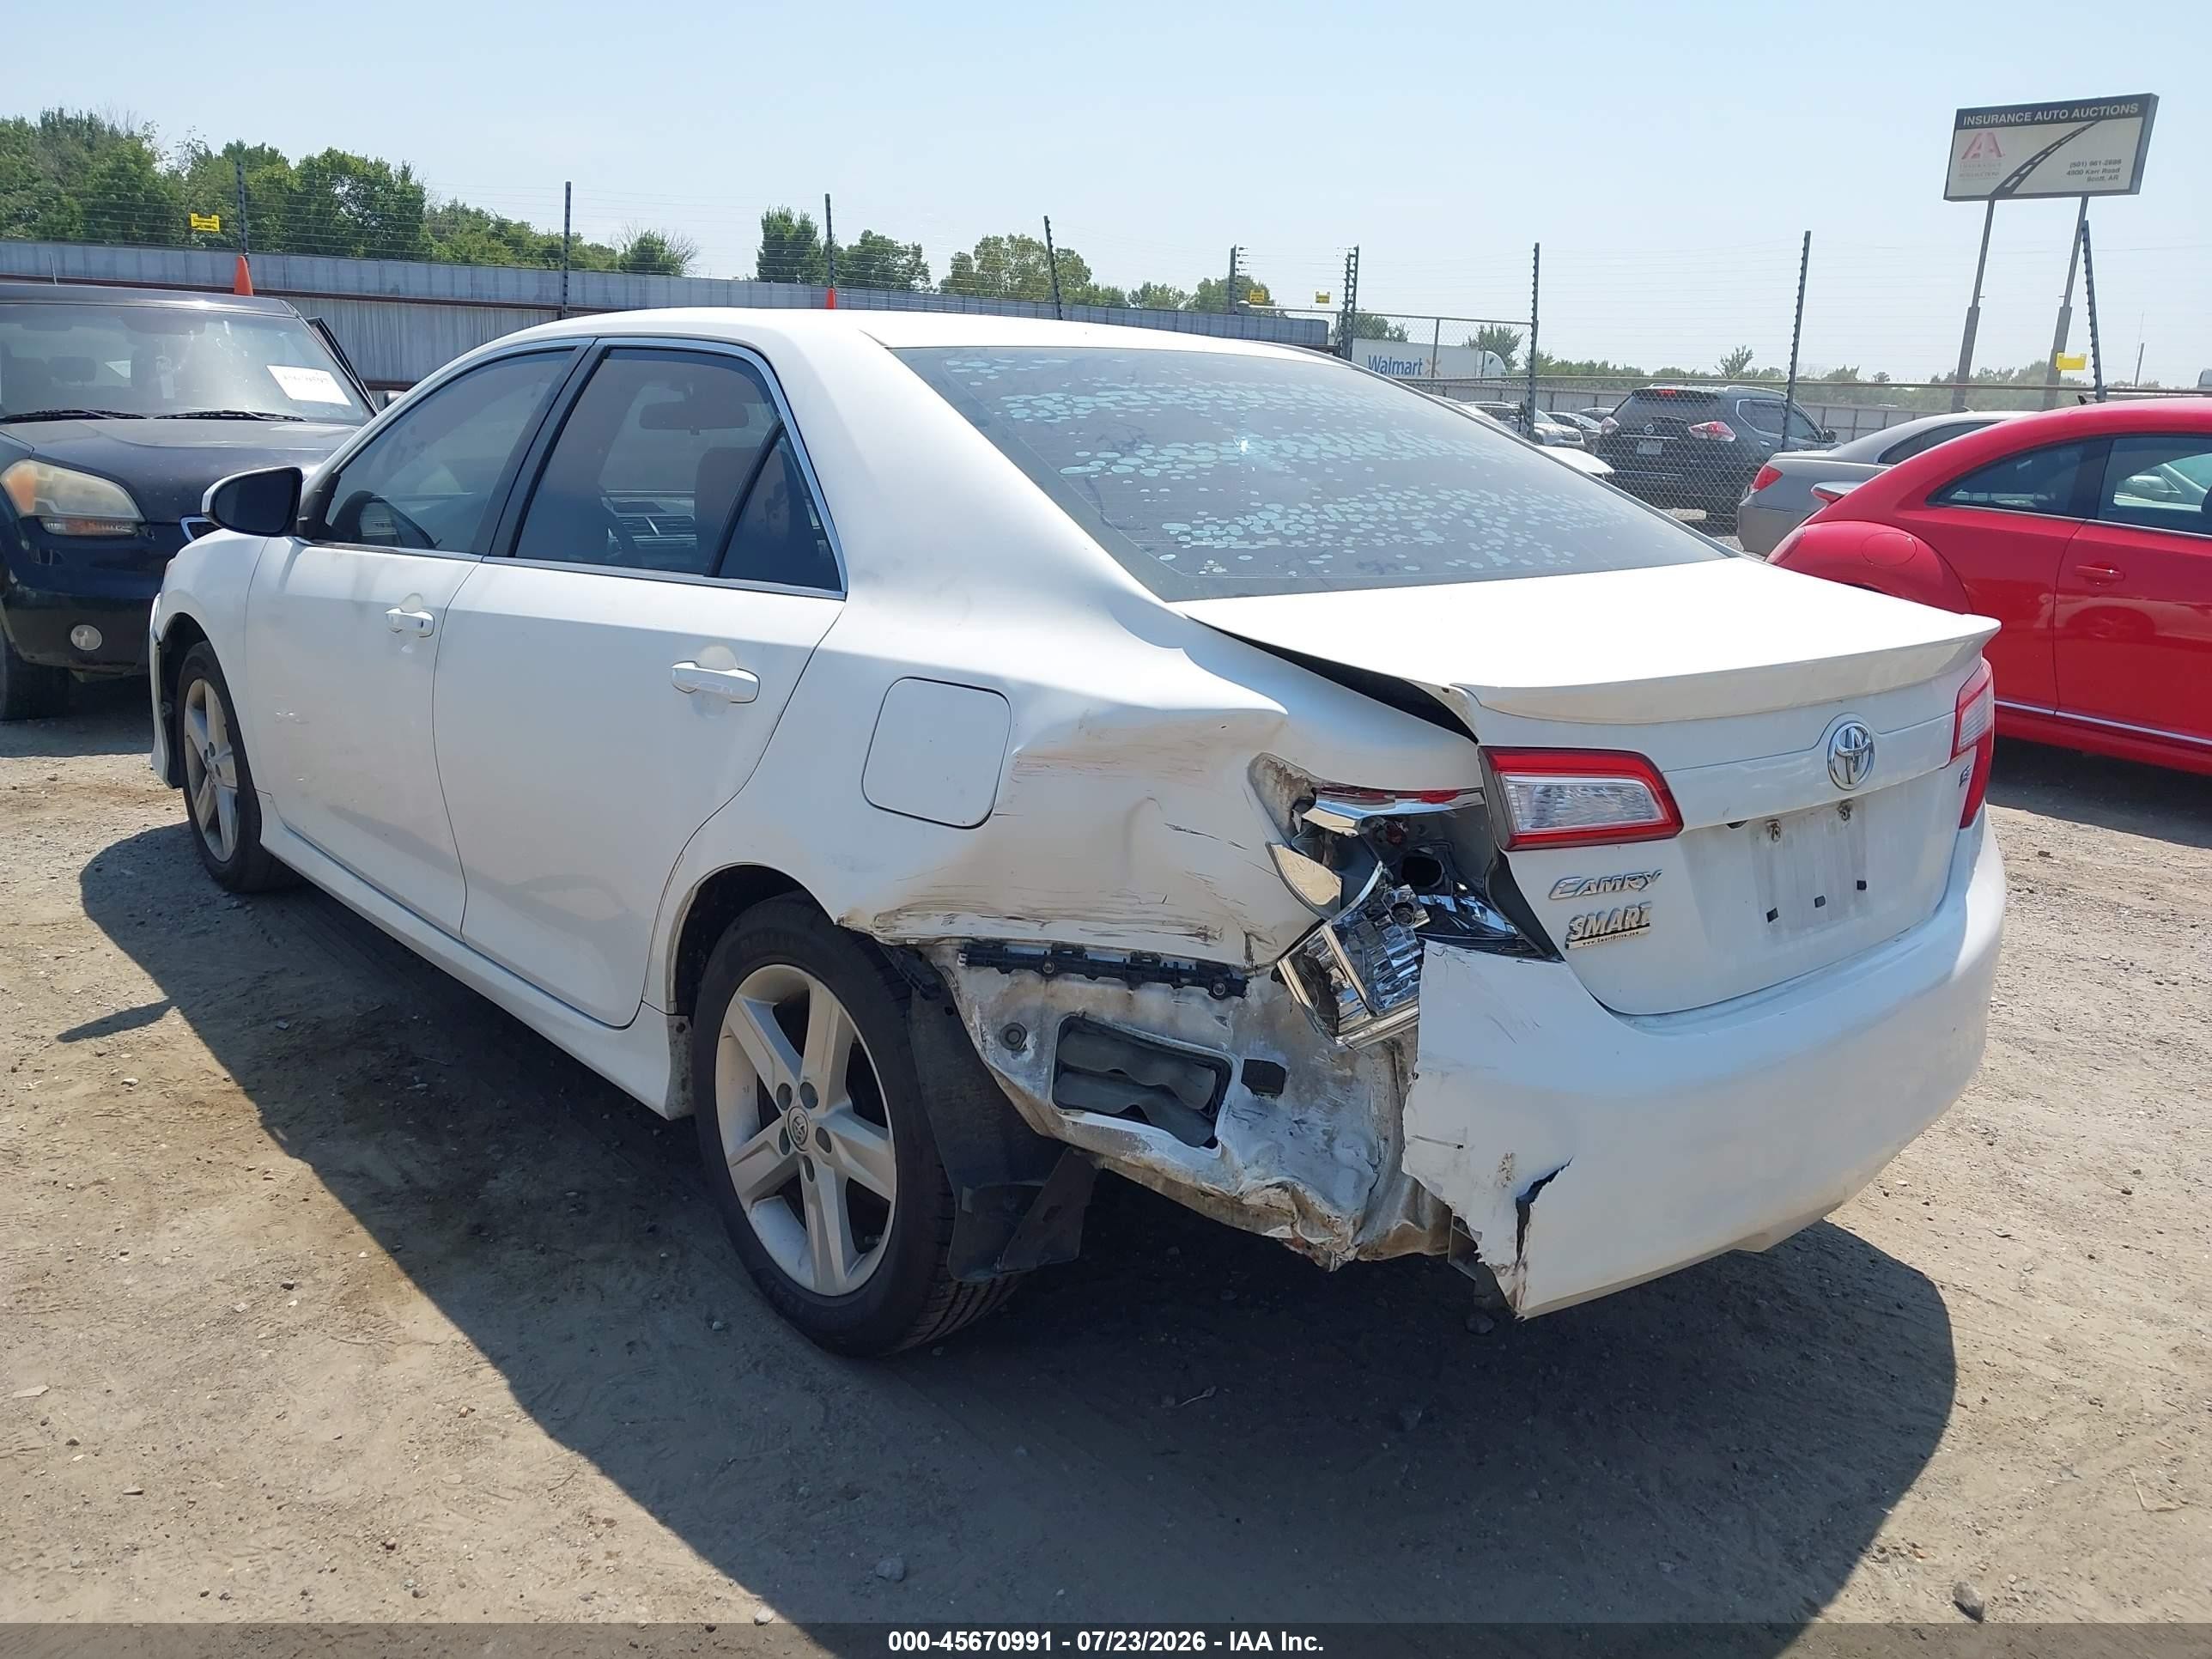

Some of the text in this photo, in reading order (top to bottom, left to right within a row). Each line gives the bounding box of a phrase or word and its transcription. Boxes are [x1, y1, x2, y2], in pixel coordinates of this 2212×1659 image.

[1963, 103, 2139, 126] INSURANCE AUTO AUCTIONS
[1368, 354, 1423, 376] Walmart
[1548, 869, 1663, 901] CAMRY
[1566, 902, 1652, 941] SMART
